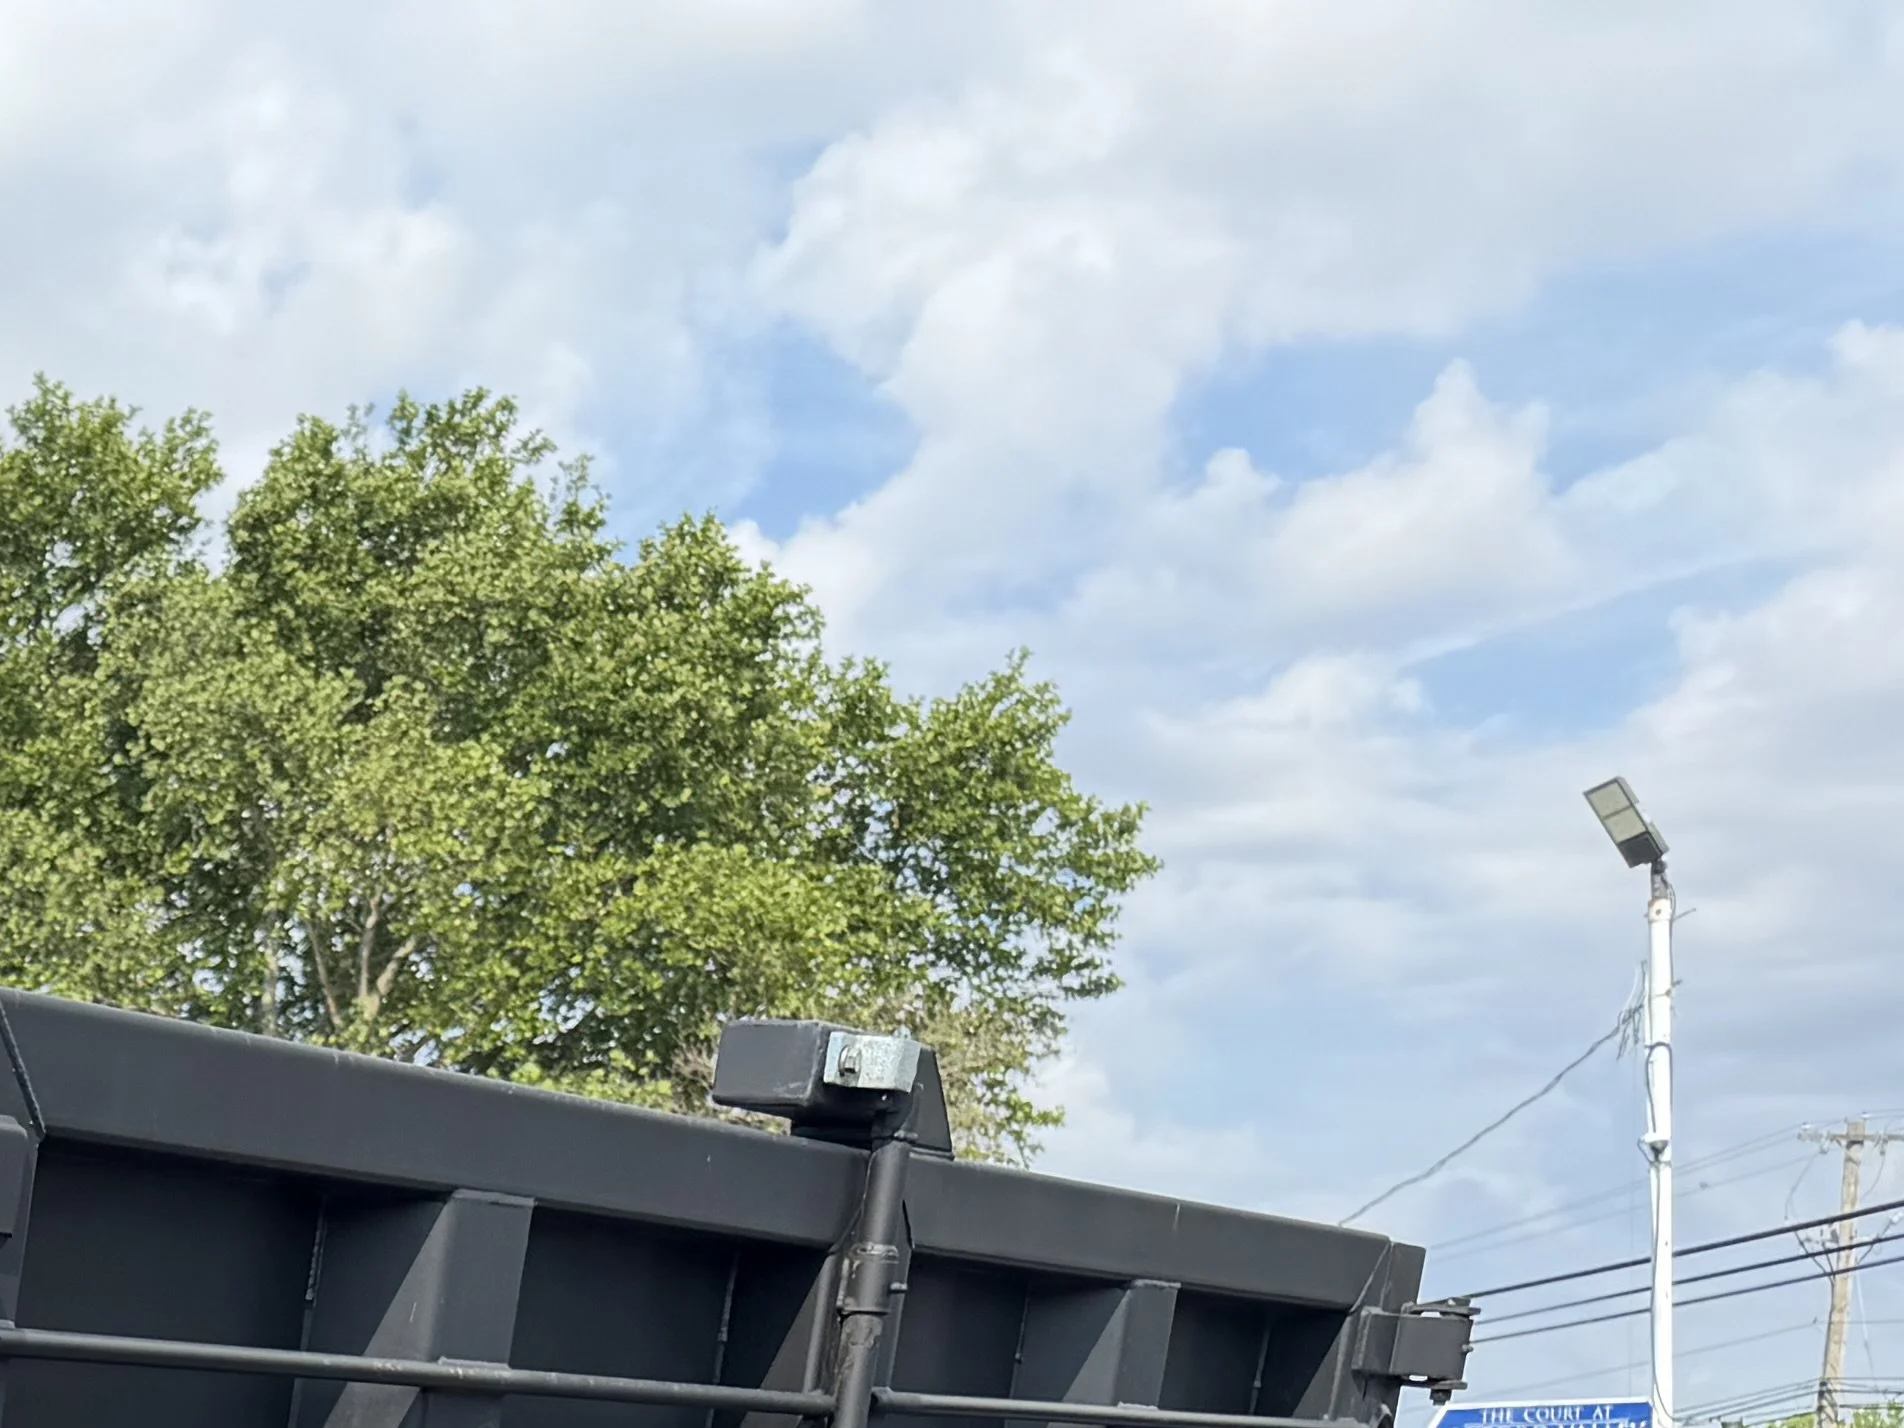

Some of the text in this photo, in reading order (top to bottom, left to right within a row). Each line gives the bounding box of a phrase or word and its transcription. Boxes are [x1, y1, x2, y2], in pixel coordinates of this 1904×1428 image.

[1480, 1405, 1613, 1424] THE COURT AT
